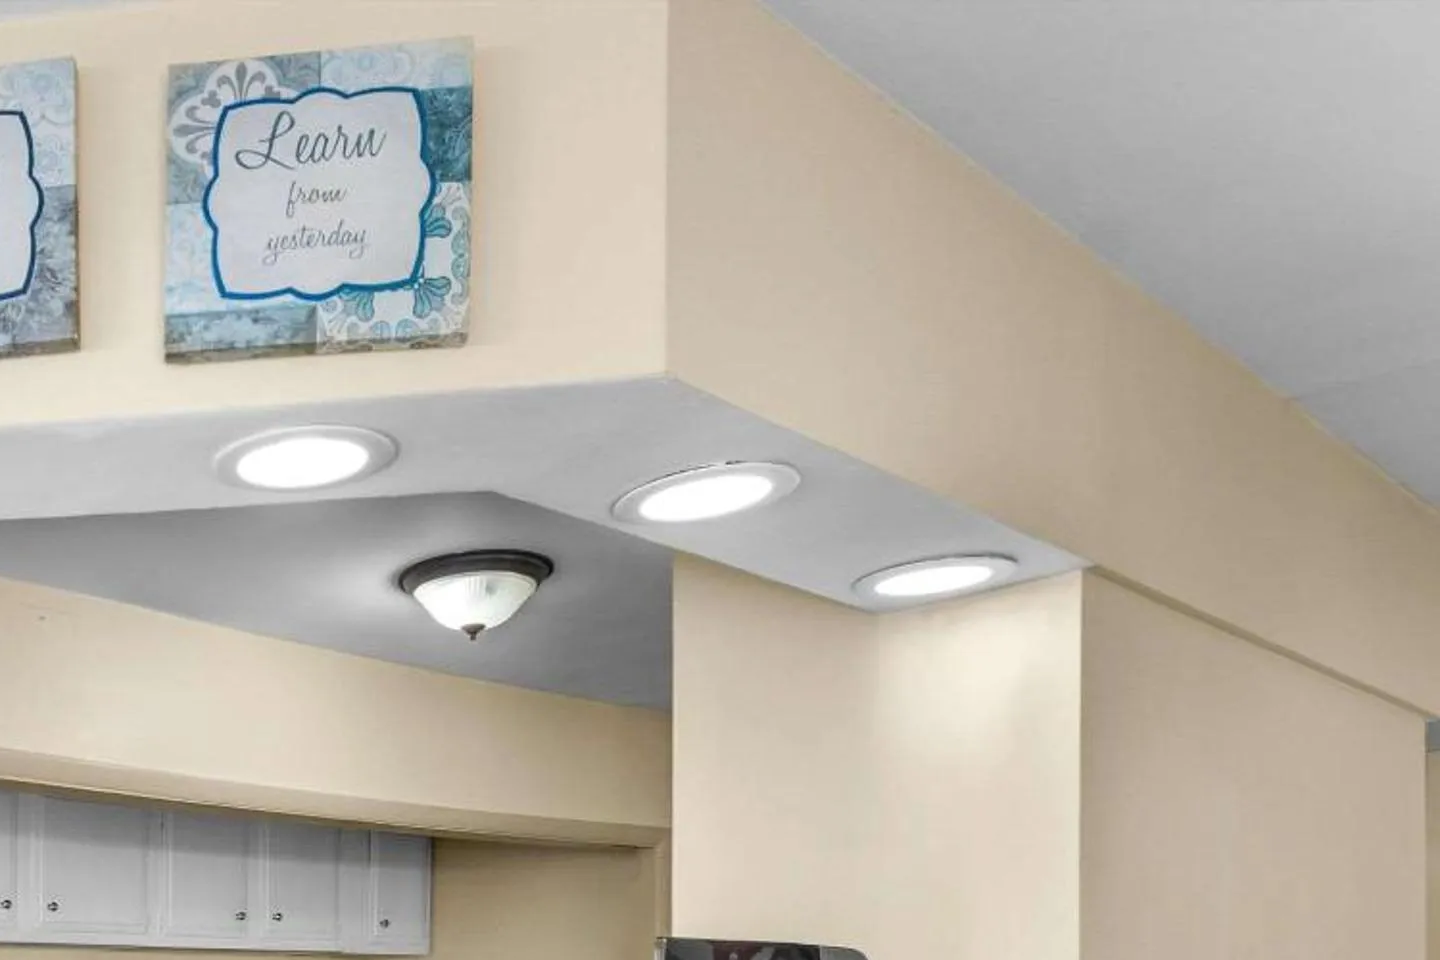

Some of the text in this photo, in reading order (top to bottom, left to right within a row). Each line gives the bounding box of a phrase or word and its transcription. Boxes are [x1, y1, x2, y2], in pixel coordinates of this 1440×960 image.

[235, 110, 387, 170] Learn
[285, 180, 347, 217] from
[263, 219, 371, 266] yesterday
